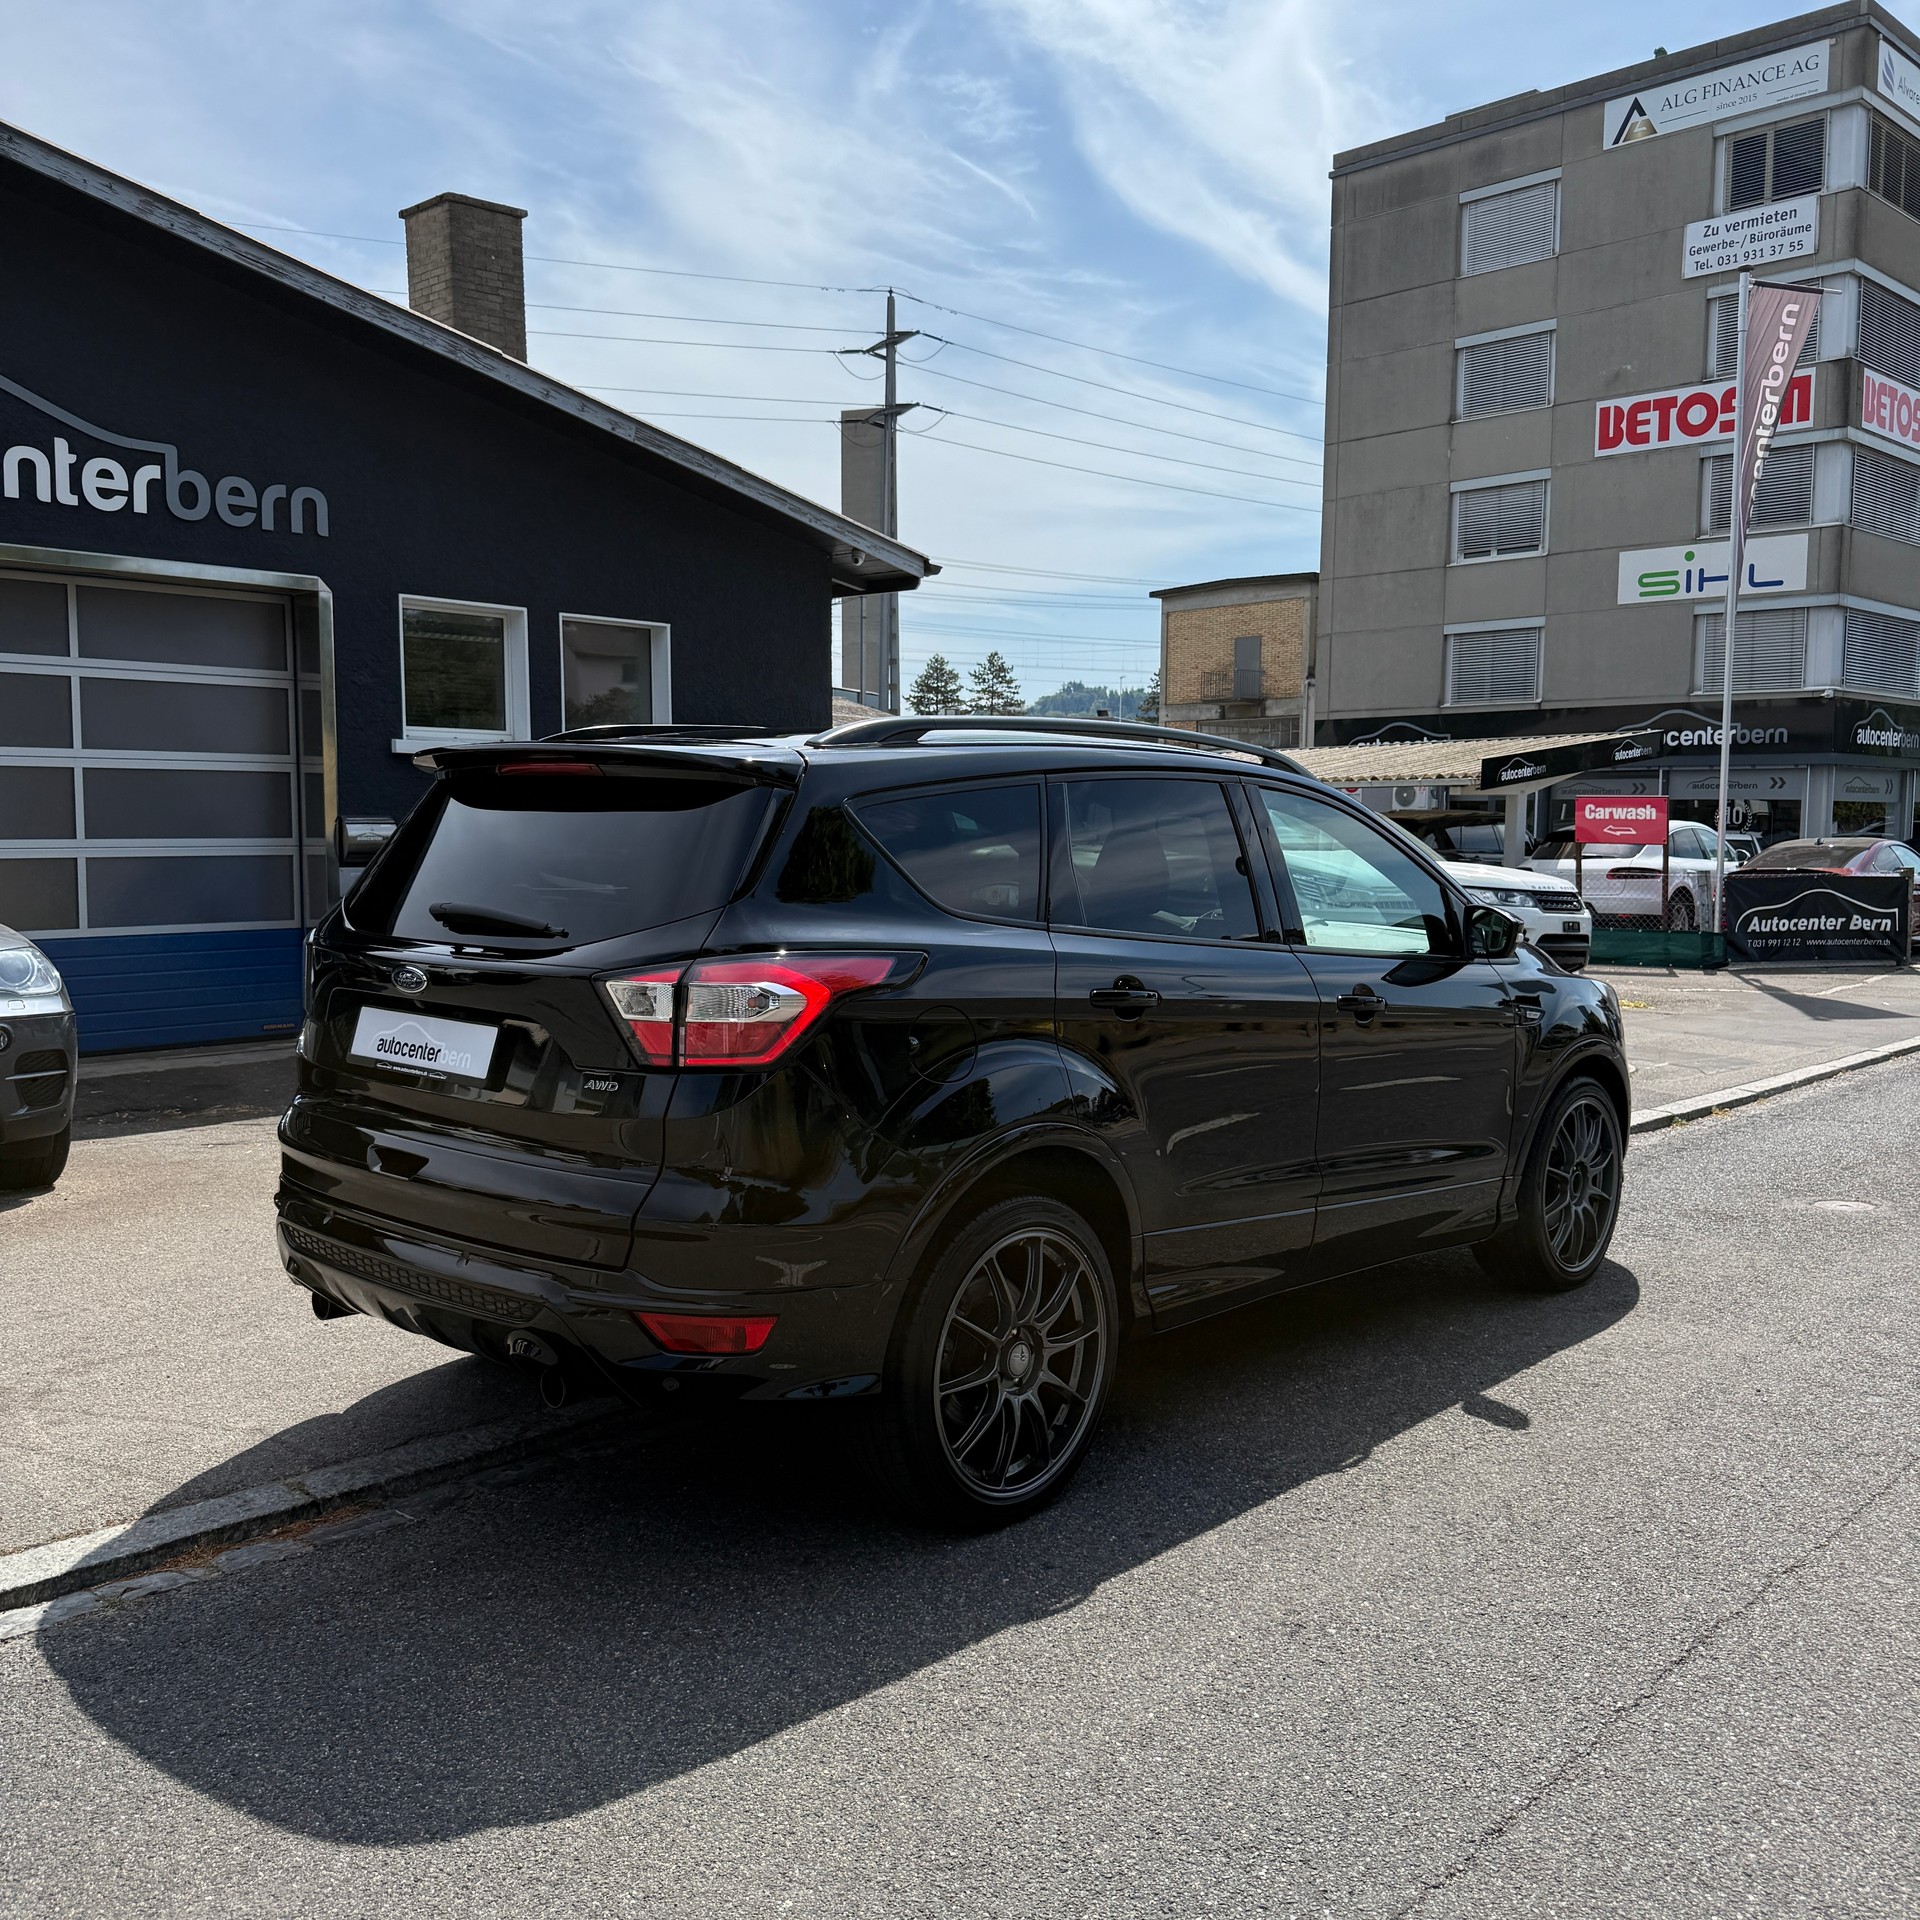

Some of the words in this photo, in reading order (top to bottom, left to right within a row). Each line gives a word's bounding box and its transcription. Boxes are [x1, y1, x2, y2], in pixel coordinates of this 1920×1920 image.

[1660, 88, 1697, 111] ALG
[1702, 64, 1786, 100] FINANCE
[1790, 54, 1819, 77] AG
[1716, 101, 1737, 111] since
[1738, 92, 1758, 105] 2015
[1703, 225, 1719, 238] Zu
[1725, 208, 1798, 233] vermieten
[1694, 259, 1713, 271] Tel.
[1717, 253, 1738, 266] 031
[1743, 248, 1764, 261] 931
[1769, 244, 1784, 256] 37
[1789, 240, 1804, 252] 55
[1750, 303, 1799, 502] enterbern
[1864, 374, 1920, 443] BETOS
[2, 437, 329, 537] nterbern
[1663, 724, 1788, 746] centerbern
[1856, 725, 1920, 748] autocenterbern
[1614, 746, 1653, 761] autocenterbern
[1501, 764, 1547, 782] autocenterbern
[1692, 781, 1758, 790] autoceerbern
[1585, 804, 1657, 820] Carwash
[1725, 806, 1743, 825] 10
[1747, 914, 1846, 933] Autocenter
[1850, 914, 1892, 932] Bern
[1752, 939, 1766, 948] 031
[1768, 939, 1781, 947] 991
[1783, 938, 1791, 947] 12
[1792, 938, 1801, 946] 12
[1806, 938, 1891, 946] www.autocenterbern.ch
[376, 1036, 471, 1069] autocenterbern
[584, 1080, 619, 1091] AWD
